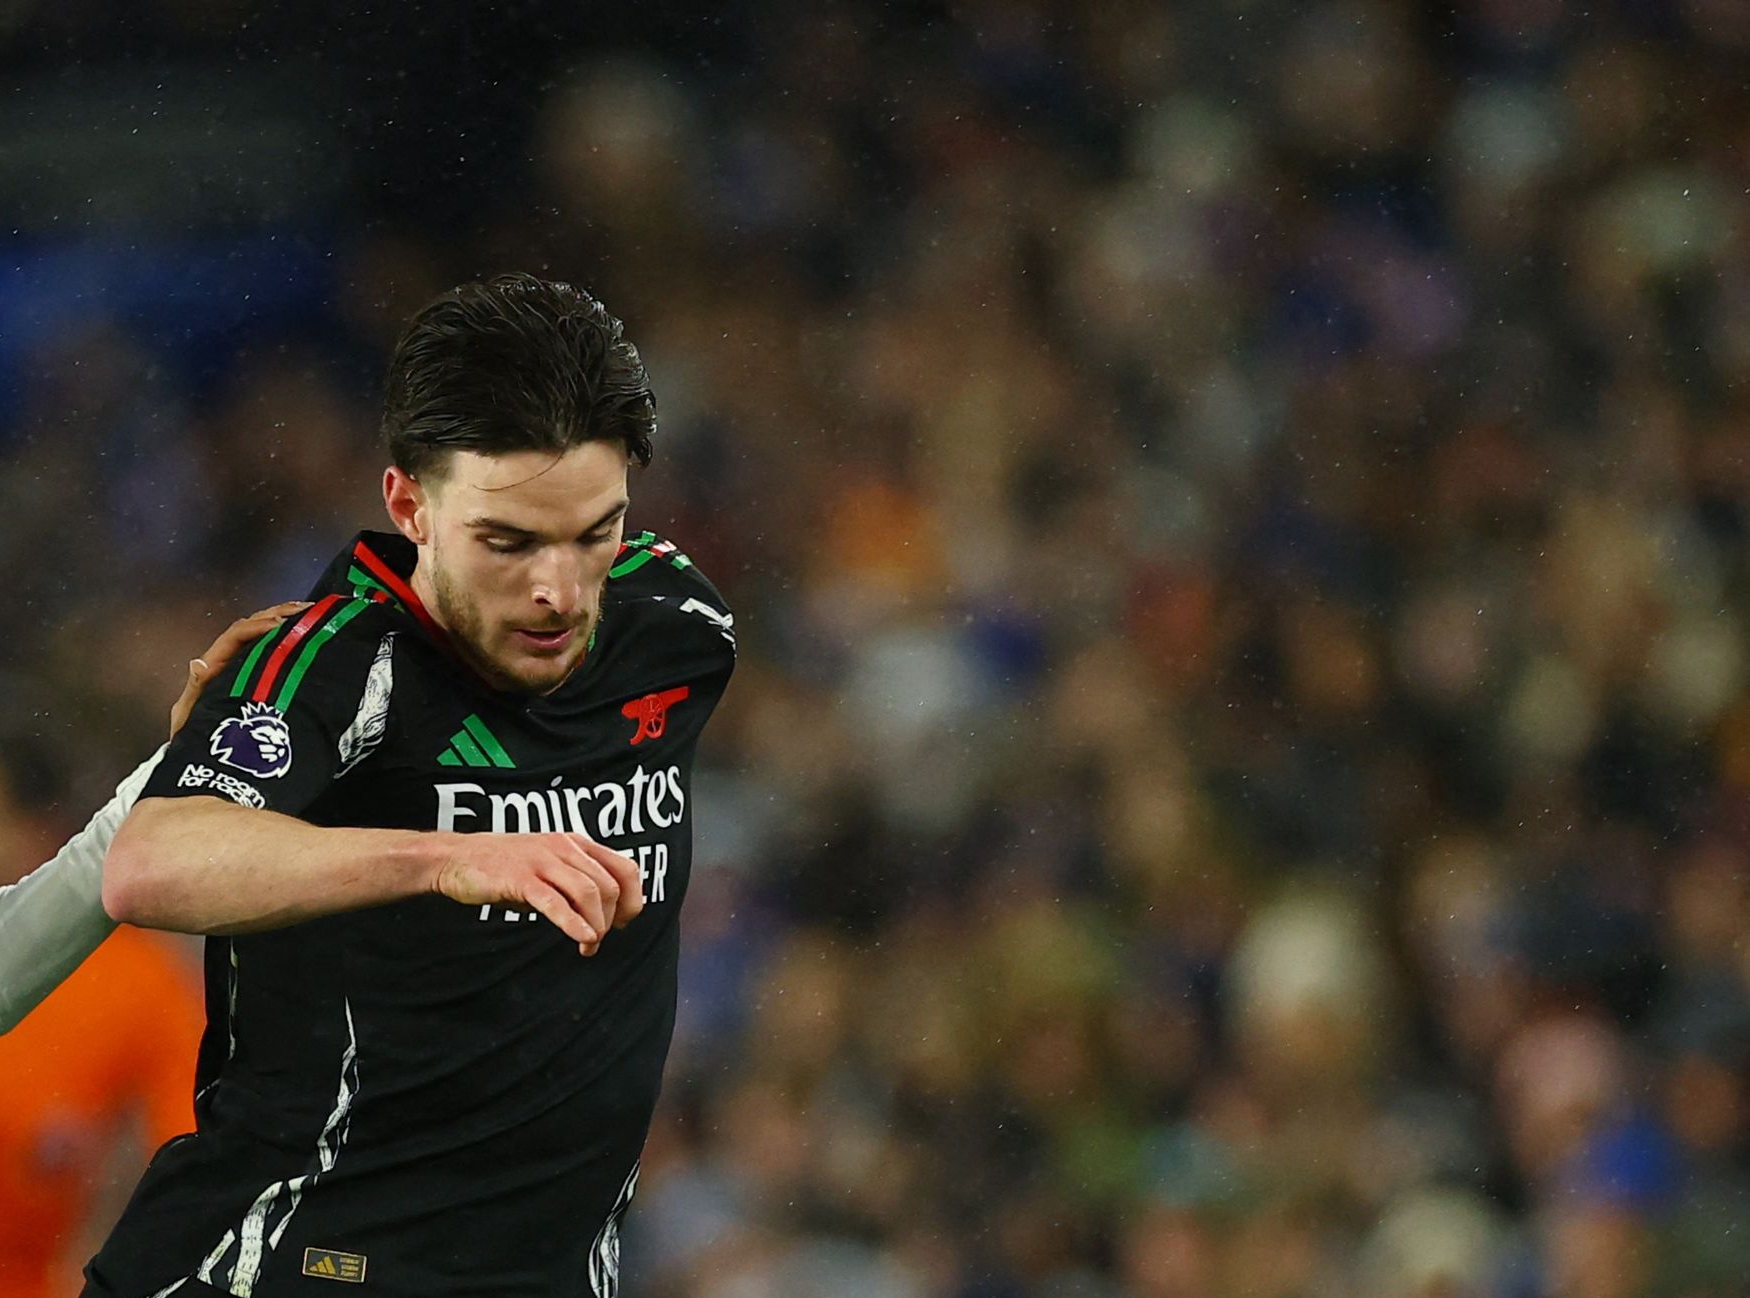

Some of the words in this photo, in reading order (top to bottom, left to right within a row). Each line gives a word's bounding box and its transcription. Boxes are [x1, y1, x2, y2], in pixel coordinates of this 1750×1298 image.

[176, 774, 210, 788] for
[182, 763, 215, 778] No
[215, 772, 266, 810] room
[433, 763, 685, 843] Emirates
